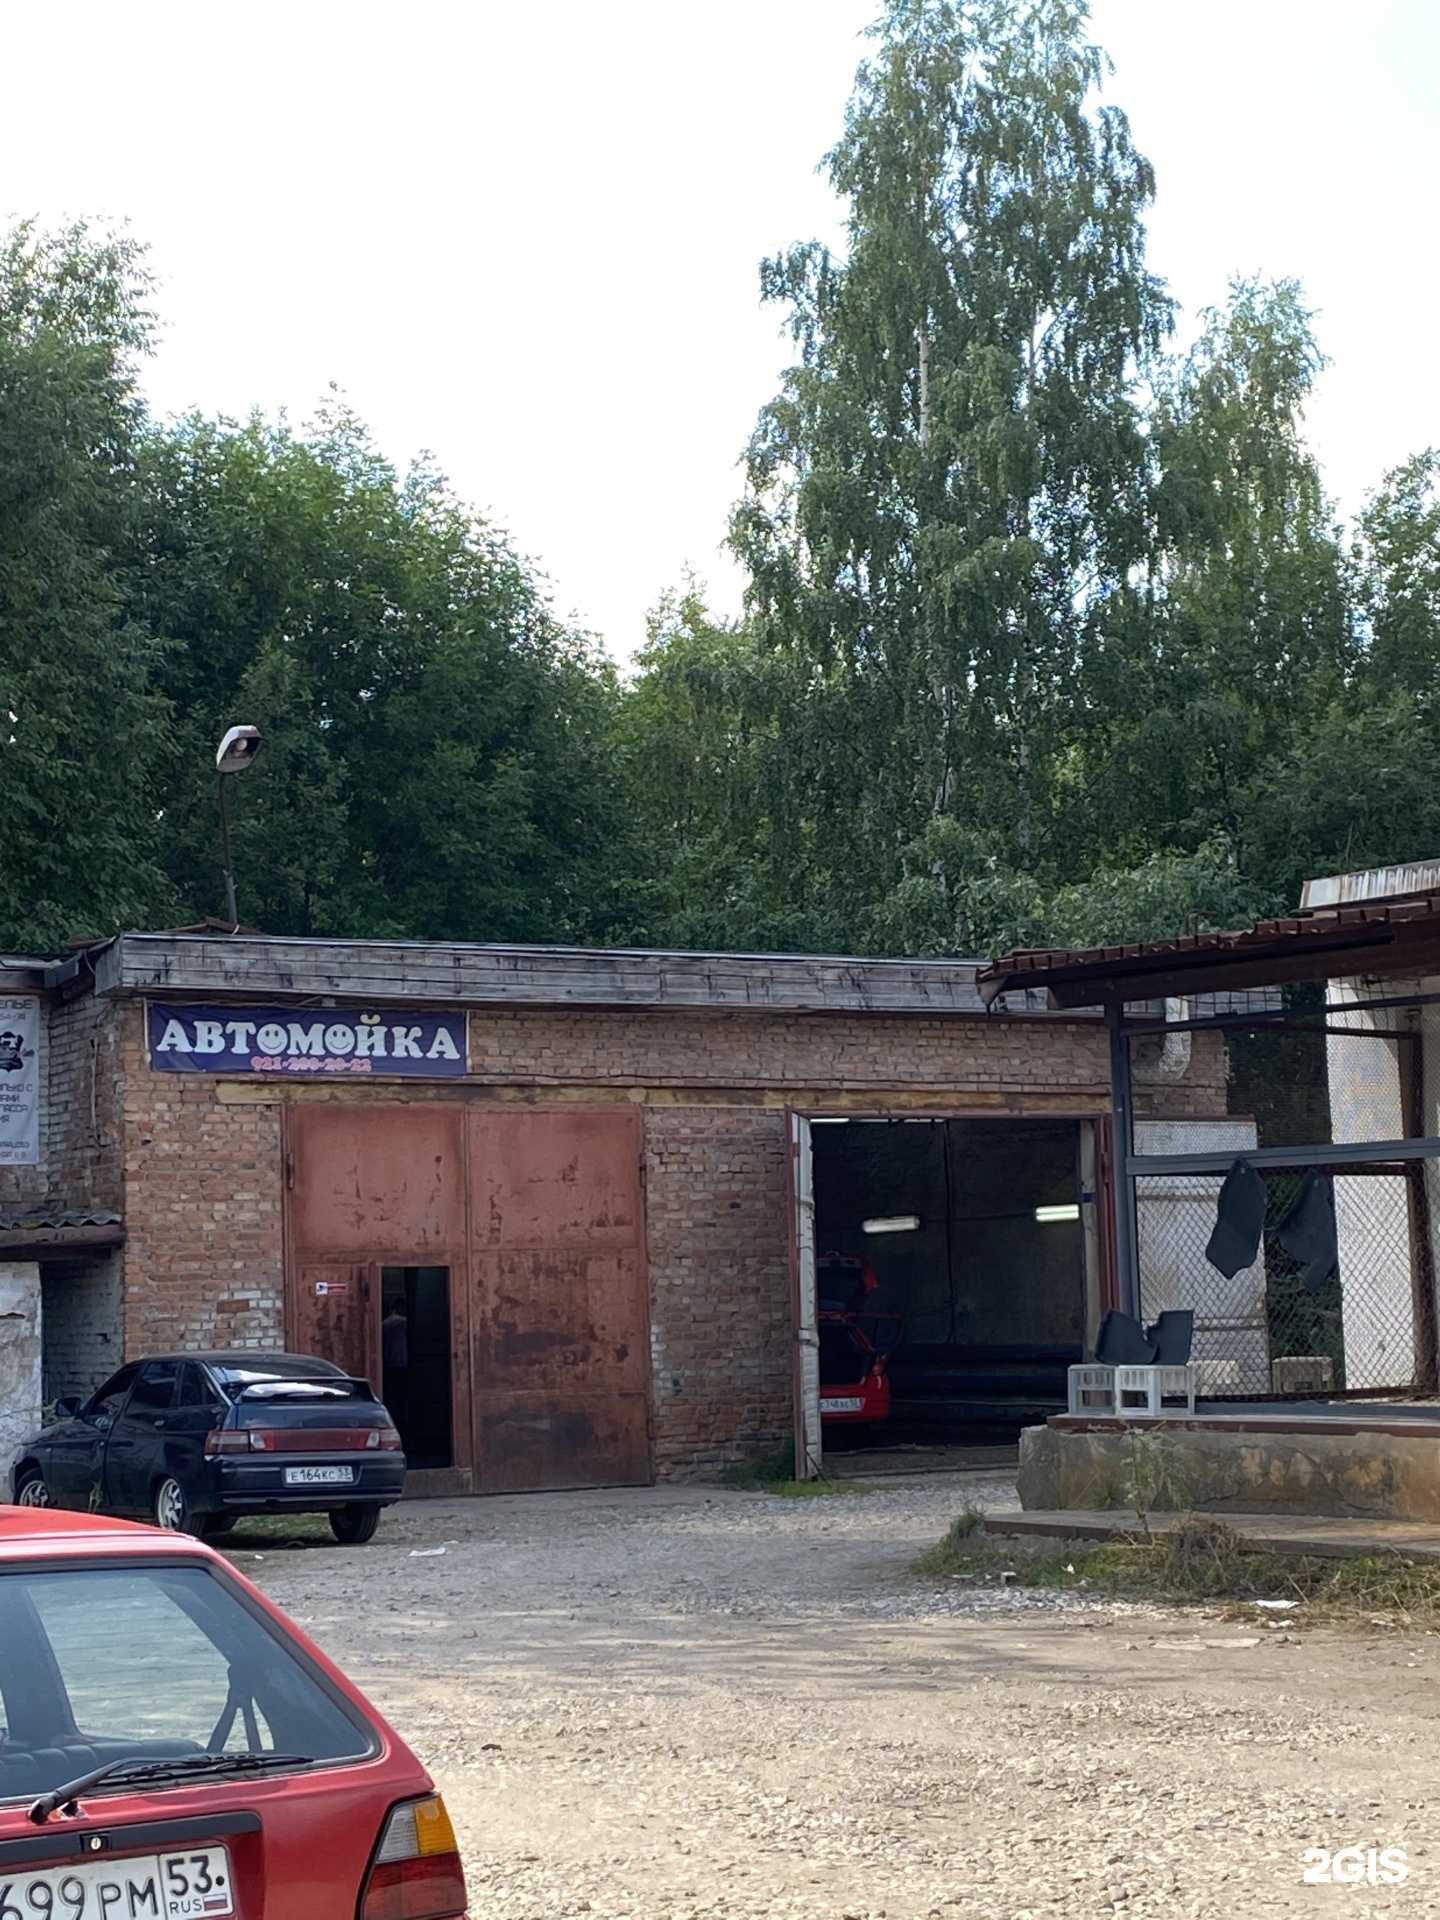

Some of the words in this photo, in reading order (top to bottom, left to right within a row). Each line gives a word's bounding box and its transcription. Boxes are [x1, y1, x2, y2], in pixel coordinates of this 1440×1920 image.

[156, 1014, 460, 1059] АВТОМОЙКА
[168, 1855, 213, 1897] 53
[169, 1899, 202, 1914] RUS
